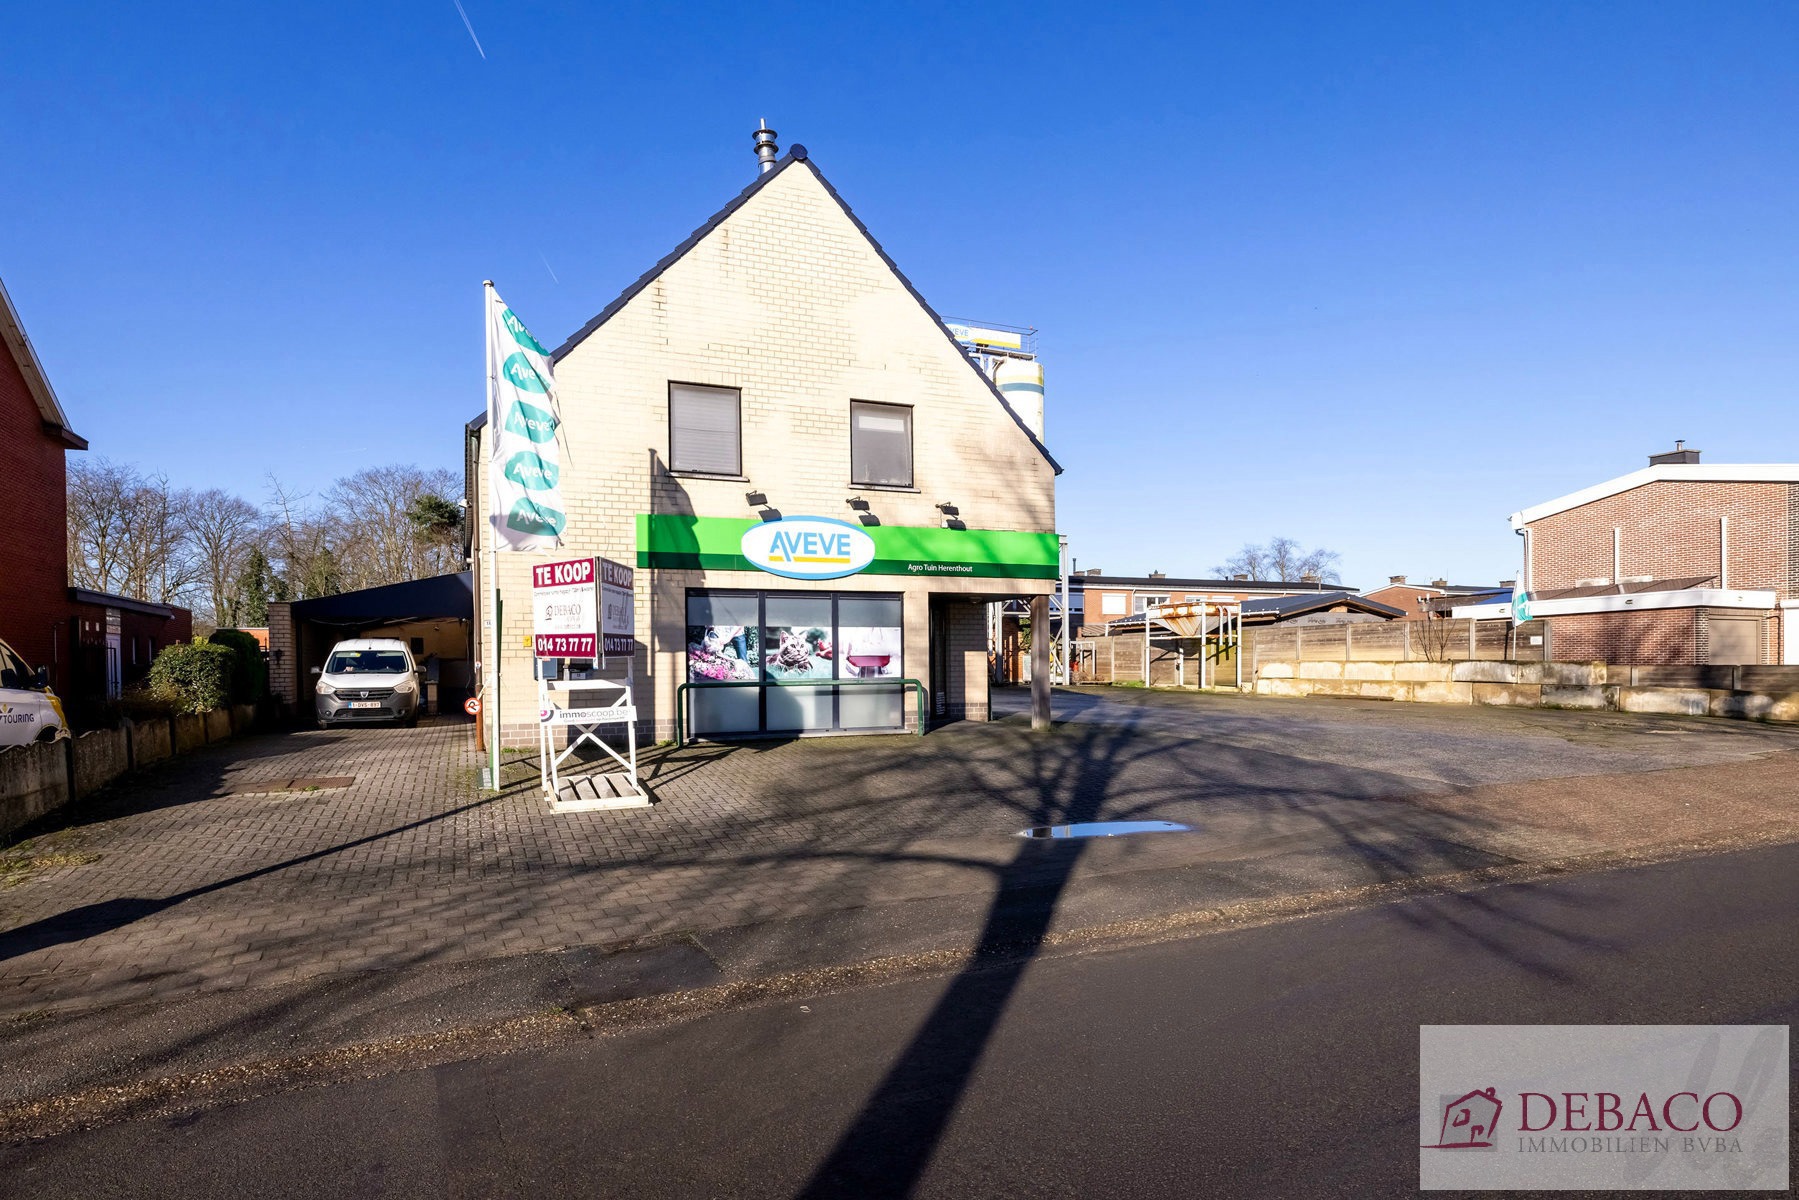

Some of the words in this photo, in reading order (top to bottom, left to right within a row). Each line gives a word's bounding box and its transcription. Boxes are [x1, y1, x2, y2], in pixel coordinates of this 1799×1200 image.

[511, 362, 536, 380] Ave
[769, 531, 850, 562] AVEVE
[536, 566, 552, 585] TE
[554, 562, 591, 583] KOOP
[601, 561, 613, 581] TE
[613, 565, 633, 587] KOOP
[908, 563, 923, 573] Agro
[924, 563, 937, 571] Tuin
[938, 564, 972, 572] Herenthout
[538, 637, 553, 651] 014
[555, 637, 566, 651] 73
[569, 637, 579, 651] 77
[581, 637, 592, 651] 77
[604, 638, 614, 651] 014
[614, 638, 621, 651] 73
[621, 638, 627, 651] 77
[627, 638, 633, 651] 77
